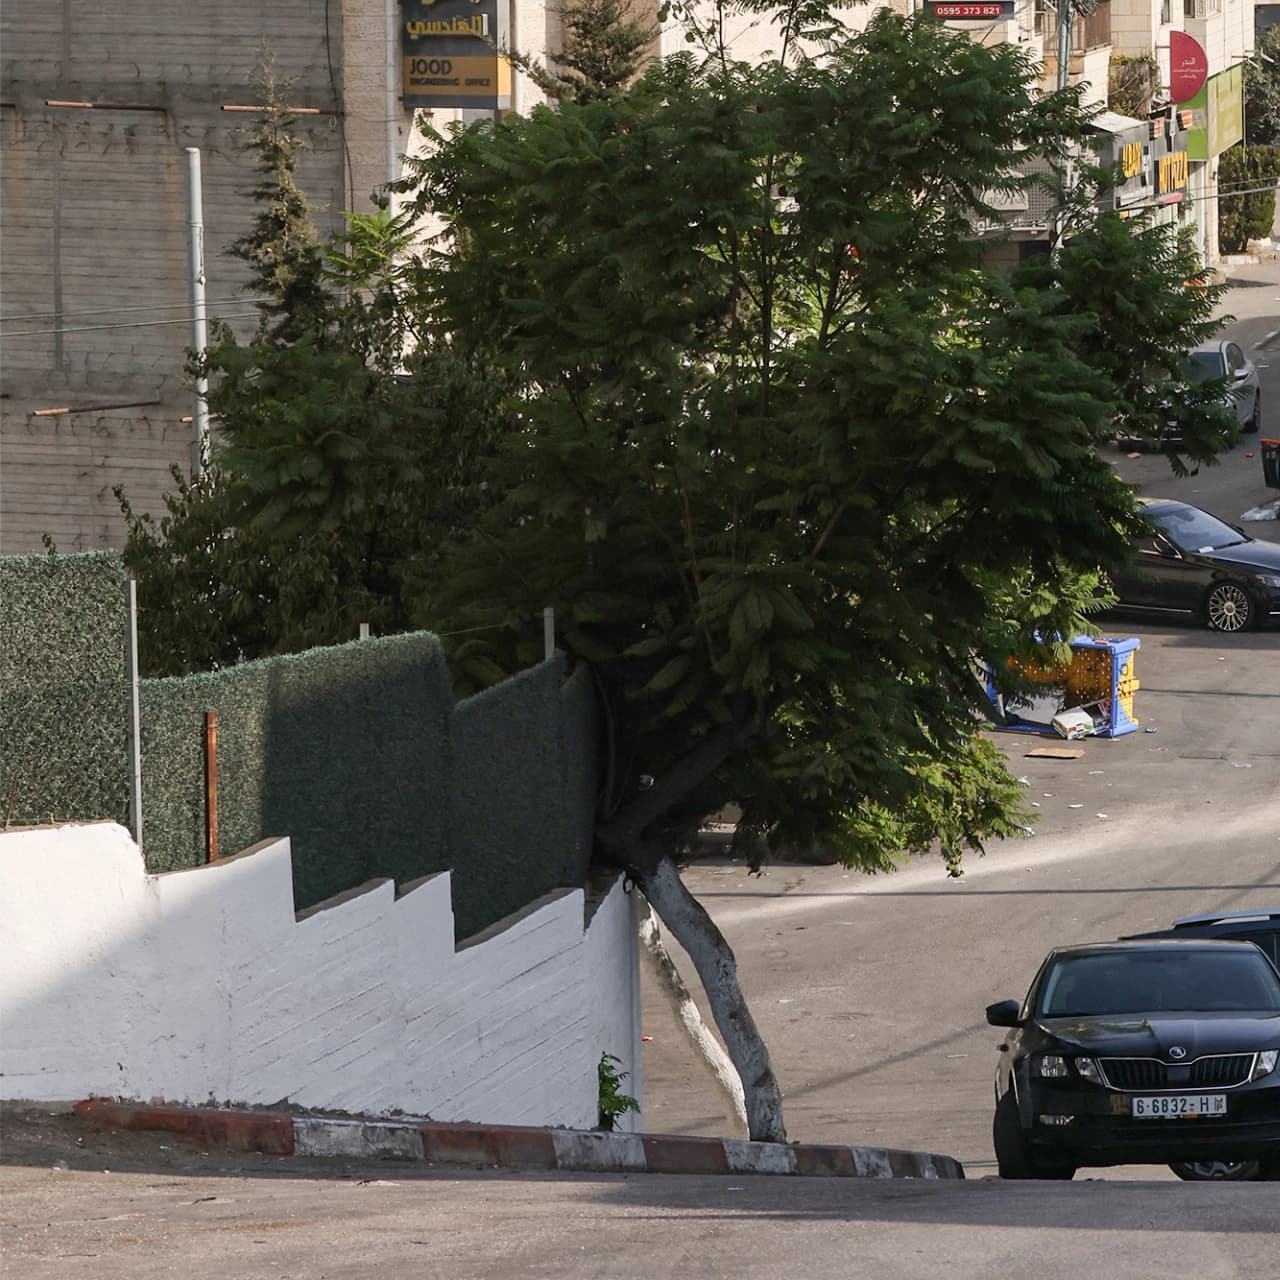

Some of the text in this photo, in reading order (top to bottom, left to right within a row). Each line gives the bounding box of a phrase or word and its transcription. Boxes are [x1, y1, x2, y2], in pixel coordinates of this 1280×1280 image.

[937, 7, 1000, 15] 0595 373 821
[410, 59, 452, 75] JOOD
